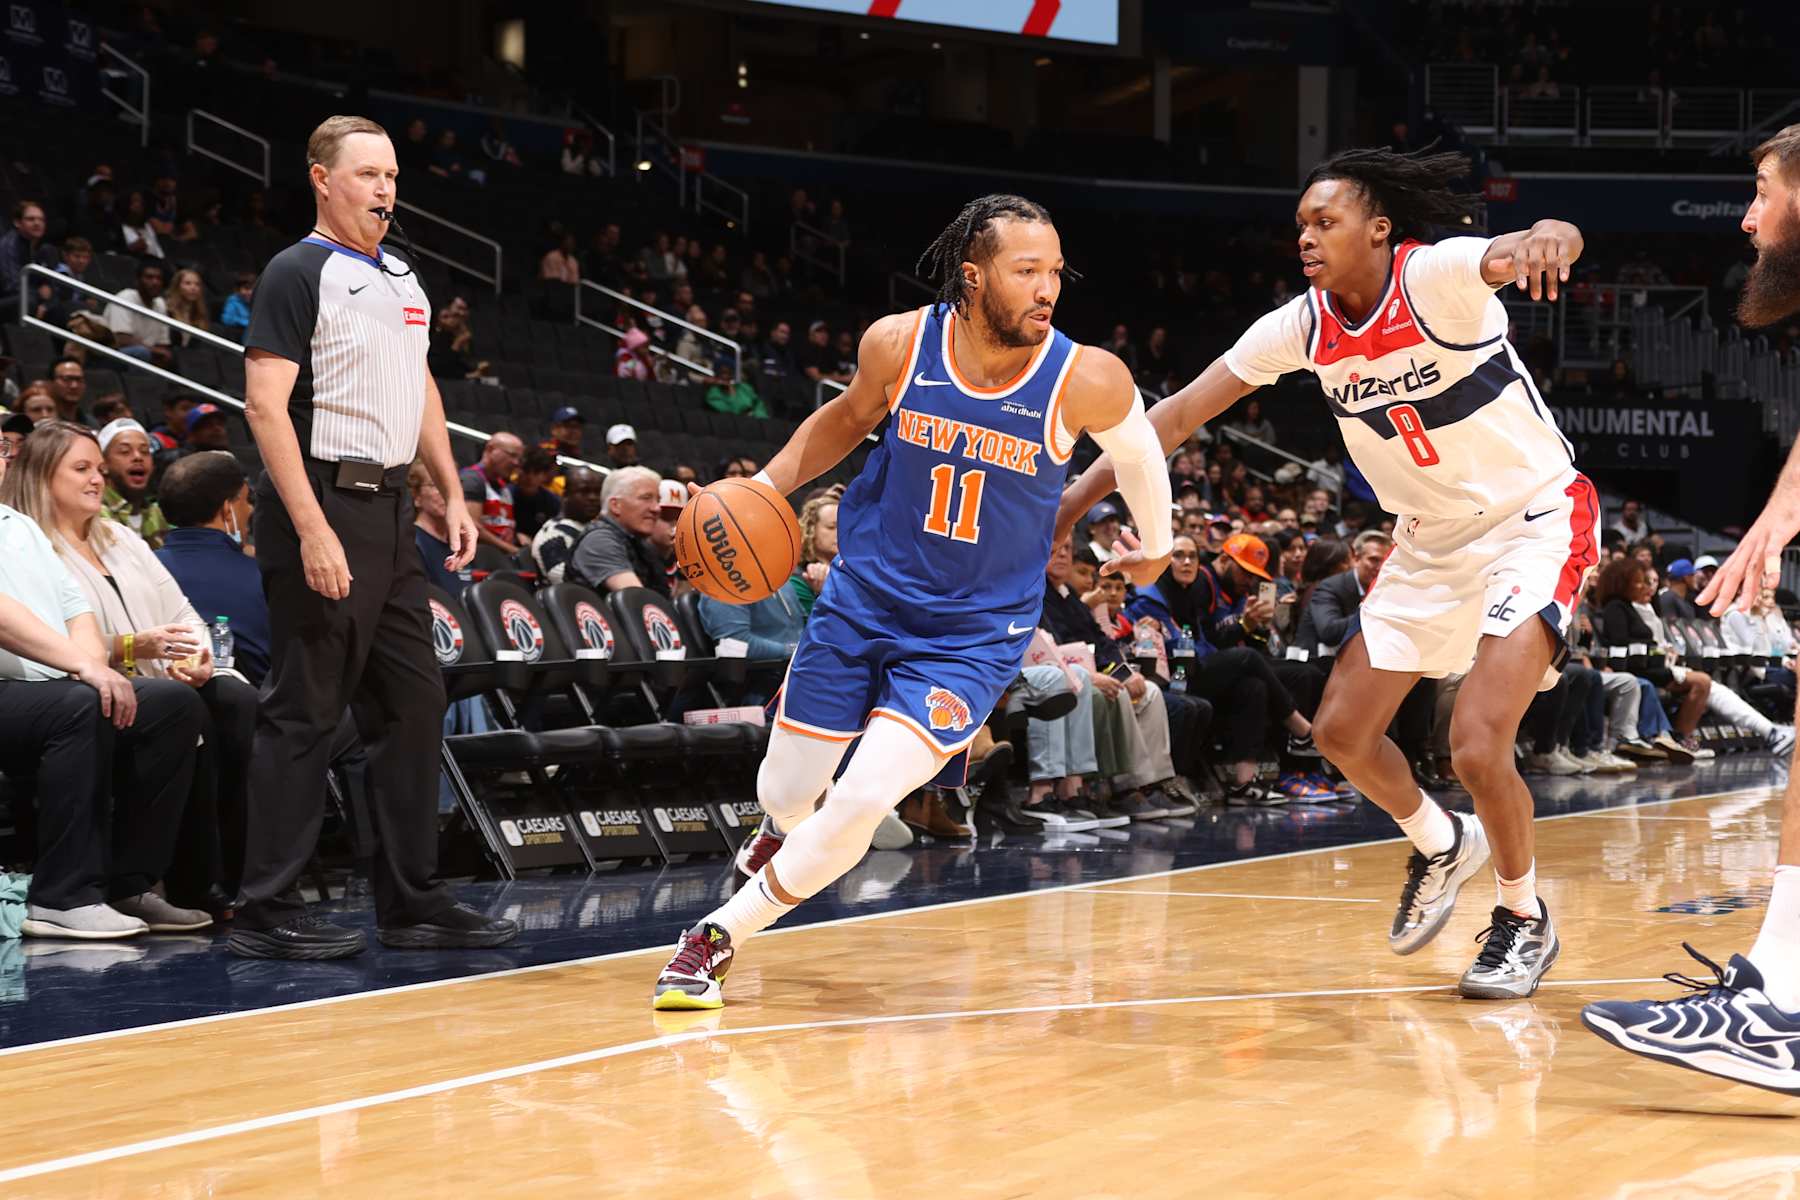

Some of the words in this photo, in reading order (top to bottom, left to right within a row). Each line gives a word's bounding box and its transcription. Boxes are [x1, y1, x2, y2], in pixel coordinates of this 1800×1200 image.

[1386, 403, 1440, 468] 8
[1551, 406, 1714, 437] ONUMENTAL
[898, 408, 961, 454] NEW
[962, 424, 1042, 477] YORK
[1617, 442, 1690, 458] CLUB
[923, 463, 986, 545] 11
[703, 513, 751, 593] Wilson
[516, 817, 566, 833] CAESARS
[595, 810, 642, 825] CAESARS
[667, 807, 709, 821] CAESARS
